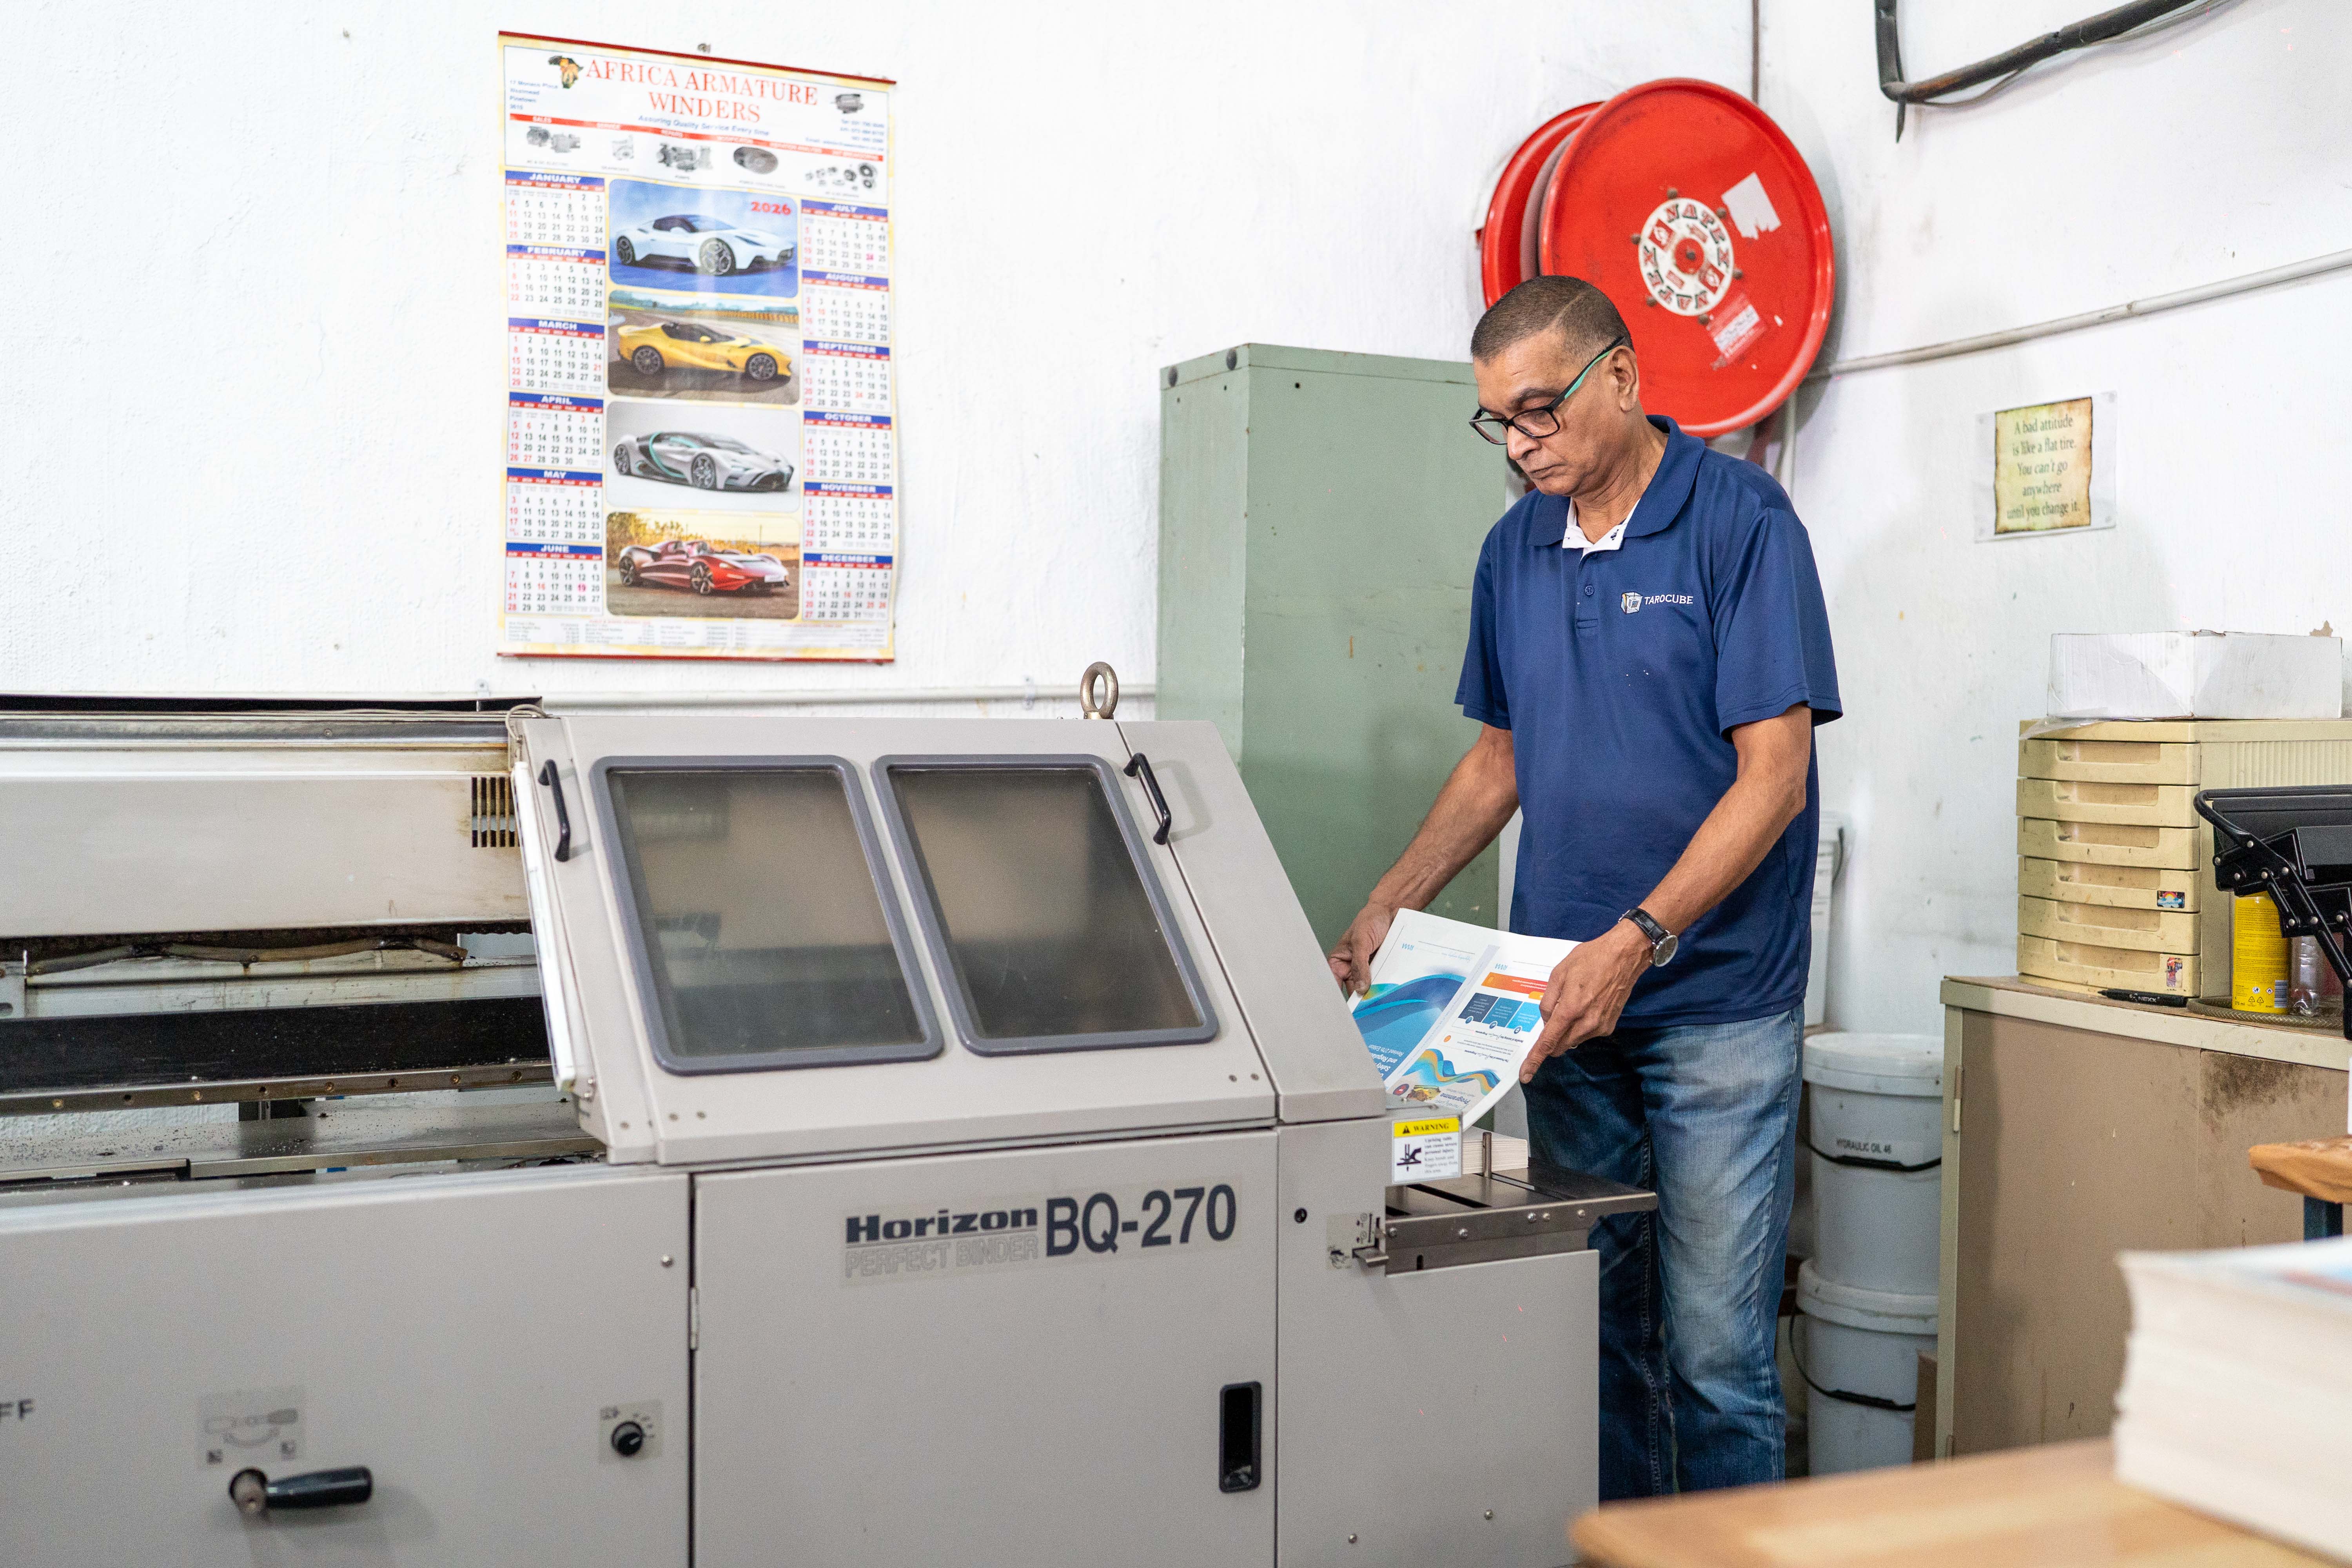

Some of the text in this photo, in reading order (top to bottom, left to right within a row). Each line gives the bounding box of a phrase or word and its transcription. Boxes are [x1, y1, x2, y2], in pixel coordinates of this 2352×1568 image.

[587, 59, 818, 106] AFRICA ARMATURE
[649, 92, 760, 123] WINDERS
[639, 115, 671, 126] Assuring
[673, 118, 697, 130] Quality
[702, 123, 729, 132] Service
[731, 125, 752, 136] Every
[530, 173, 581, 183] JANUARY
[751, 201, 792, 216] 2026
[832, 204, 857, 212] JULY
[527, 246, 586, 256] FEBRUARY
[826, 273, 867, 283] AUGUST
[539, 320, 577, 330] MARCH
[817, 342, 876, 353] SEPTEMBER
[541, 396, 572, 405] APRIL
[824, 413, 872, 422] OCTOBER
[513, 421, 517, 429] 5
[2014, 414, 2073, 435] A bad attitude
[551, 445, 559, 454] 22
[564, 446, 573, 454] 23
[2013, 443, 2019, 456] is
[2021, 440, 2035, 455] like
[2038, 443, 2042, 452] a
[2044, 437, 2058, 452] flat
[2018, 462, 2031, 475] You
[2057, 461, 2068, 476] go
[821, 484, 876, 492] NOVEMBER
[2023, 480, 2062, 500] anywhere
[2007, 504, 2024, 519] until
[2027, 506, 2040, 521] you
[2042, 501, 2069, 517] change
[821, 554, 876, 563] DECEMBER
[553, 561, 557, 570] 3
[577, 584, 586, 592] 19
[508, 592, 517, 601] 21
[551, 593, 559, 602] 24
[564, 594, 572, 602] 25
[1644, 594, 1694, 605] TAROCUBE
[508, 603, 517, 611] 28
[1376, 1062, 1391, 1072] Safety
[1440, 1093, 1471, 1105] Programme
[1414, 1123, 1450, 1132] WARNING
[846, 1184, 1237, 1258] Horizon BQ-270
[845, 1233, 1040, 1279] PERFECT BINDER
